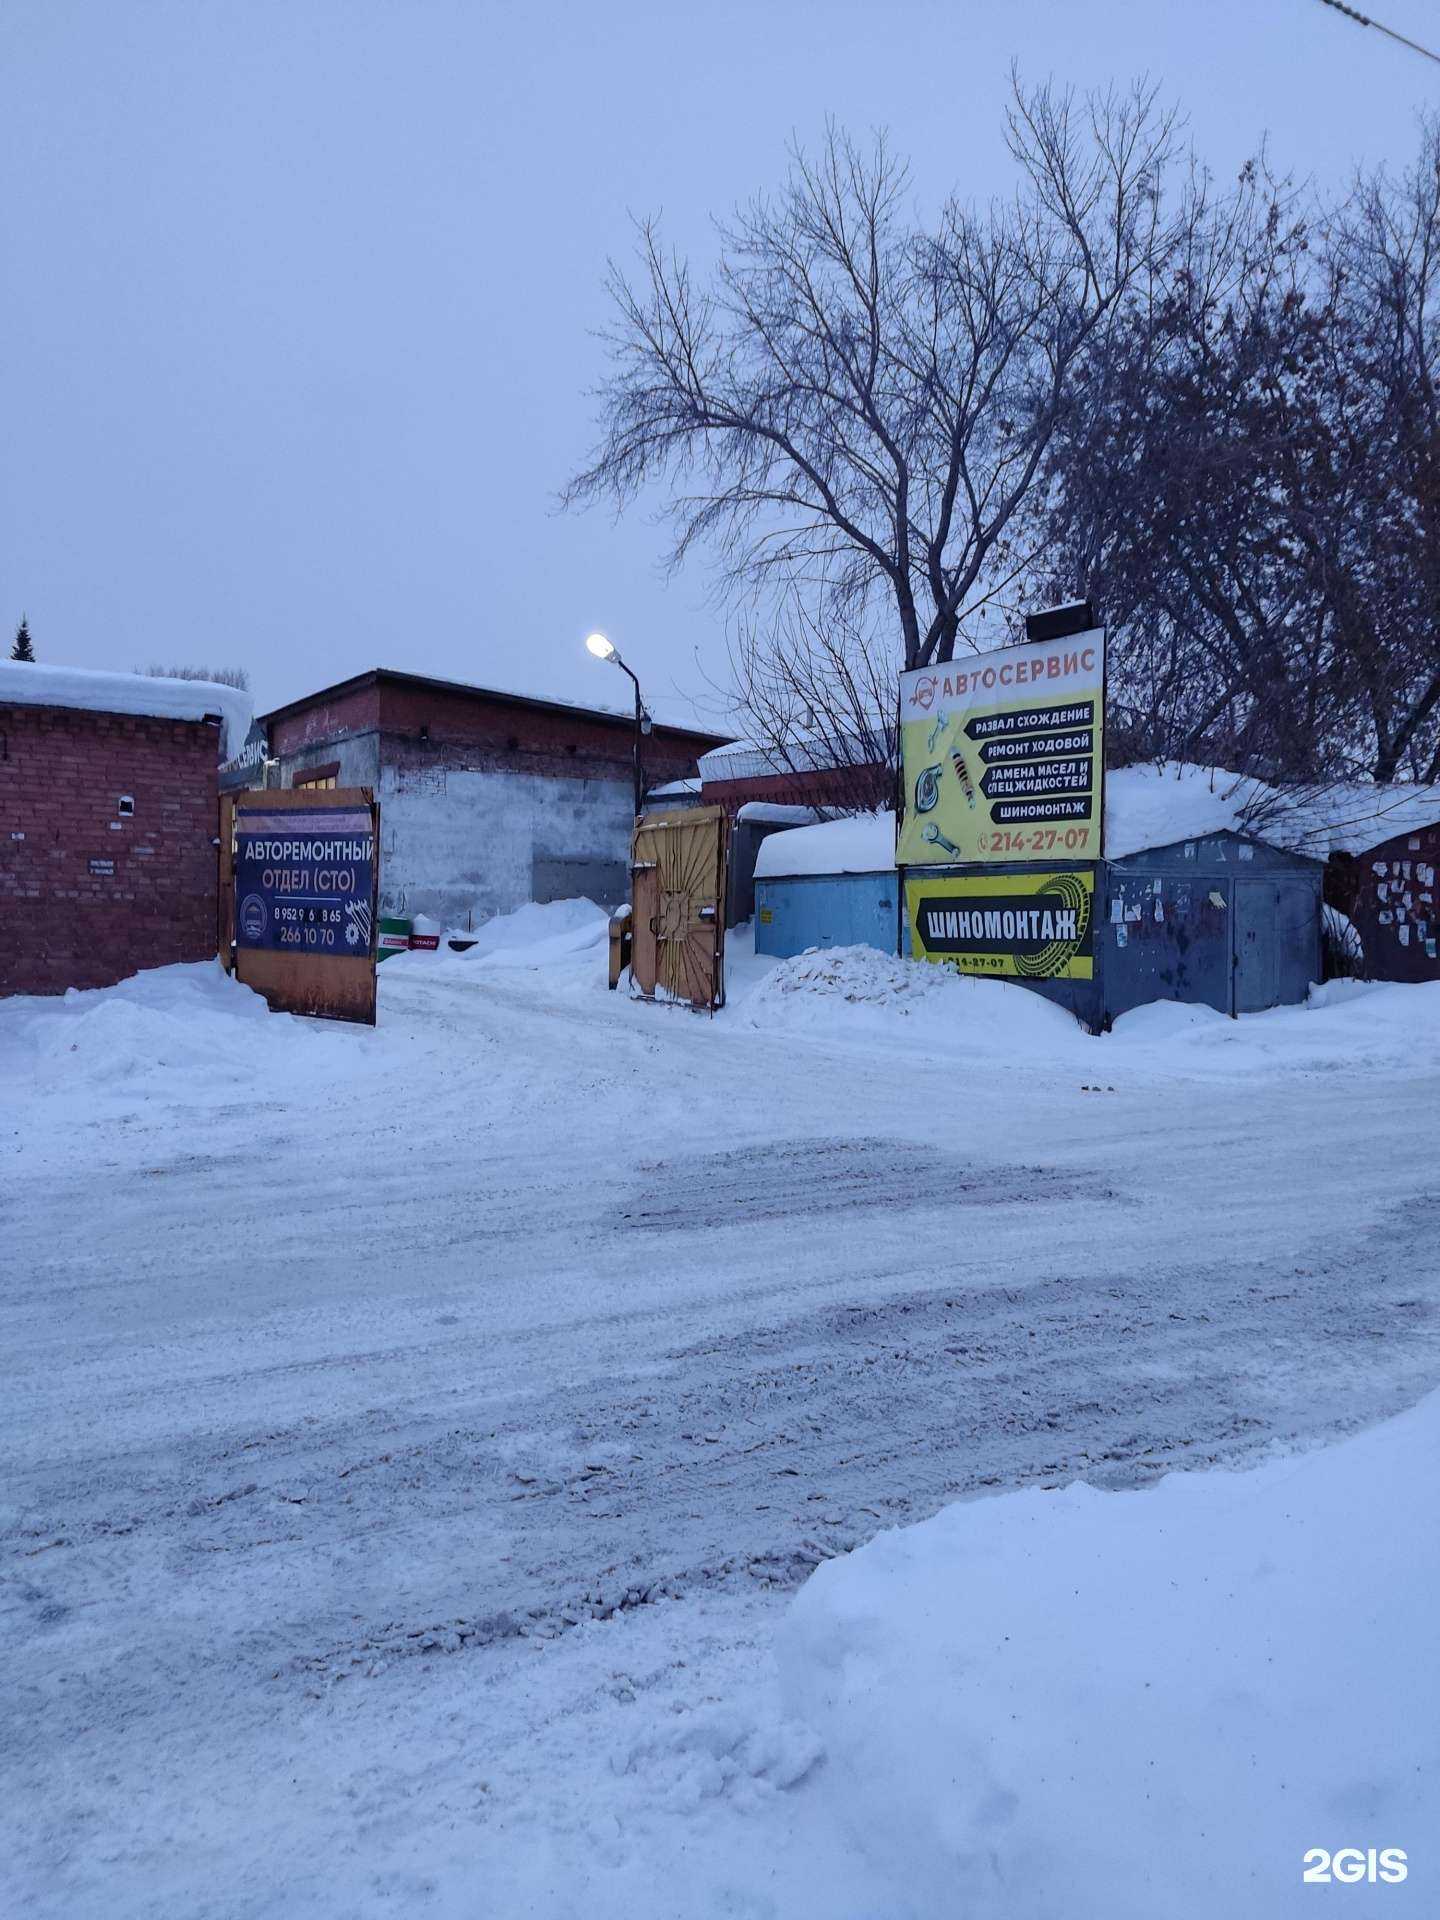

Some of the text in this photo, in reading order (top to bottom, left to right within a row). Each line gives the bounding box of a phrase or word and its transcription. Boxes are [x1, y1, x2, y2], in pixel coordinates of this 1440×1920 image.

[942, 648, 1095, 698] АВТОСЕРВИС
[976, 708, 1090, 733] РАЗВАЛ СХОЖДЕНИЕ
[988, 734, 1089, 757] РЕМОНТ ХОДОВОЙ
[991, 761, 1088, 780] ЗАМЕНА МАСЕЛ И
[988, 772, 1088, 793] СПЕЦЖИДКОСТЕЙ
[1000, 802, 1085, 818] ШИНОМОНТАЖ
[245, 836, 373, 861] АВТОРЕМОНТНЫЙ
[990, 828, 1090, 851] 214-27-07
[262, 868, 356, 892] ОТДЕЛ (СТО)
[274, 907, 280, 920] 8
[281, 908, 297, 920] 952
[329, 910, 341, 922] 65
[927, 910, 1077, 940] ШИНОМОНТАЖ
[280, 926, 301, 943] 266
[303, 927, 317, 944] 10
[320, 929, 335, 945] 70
